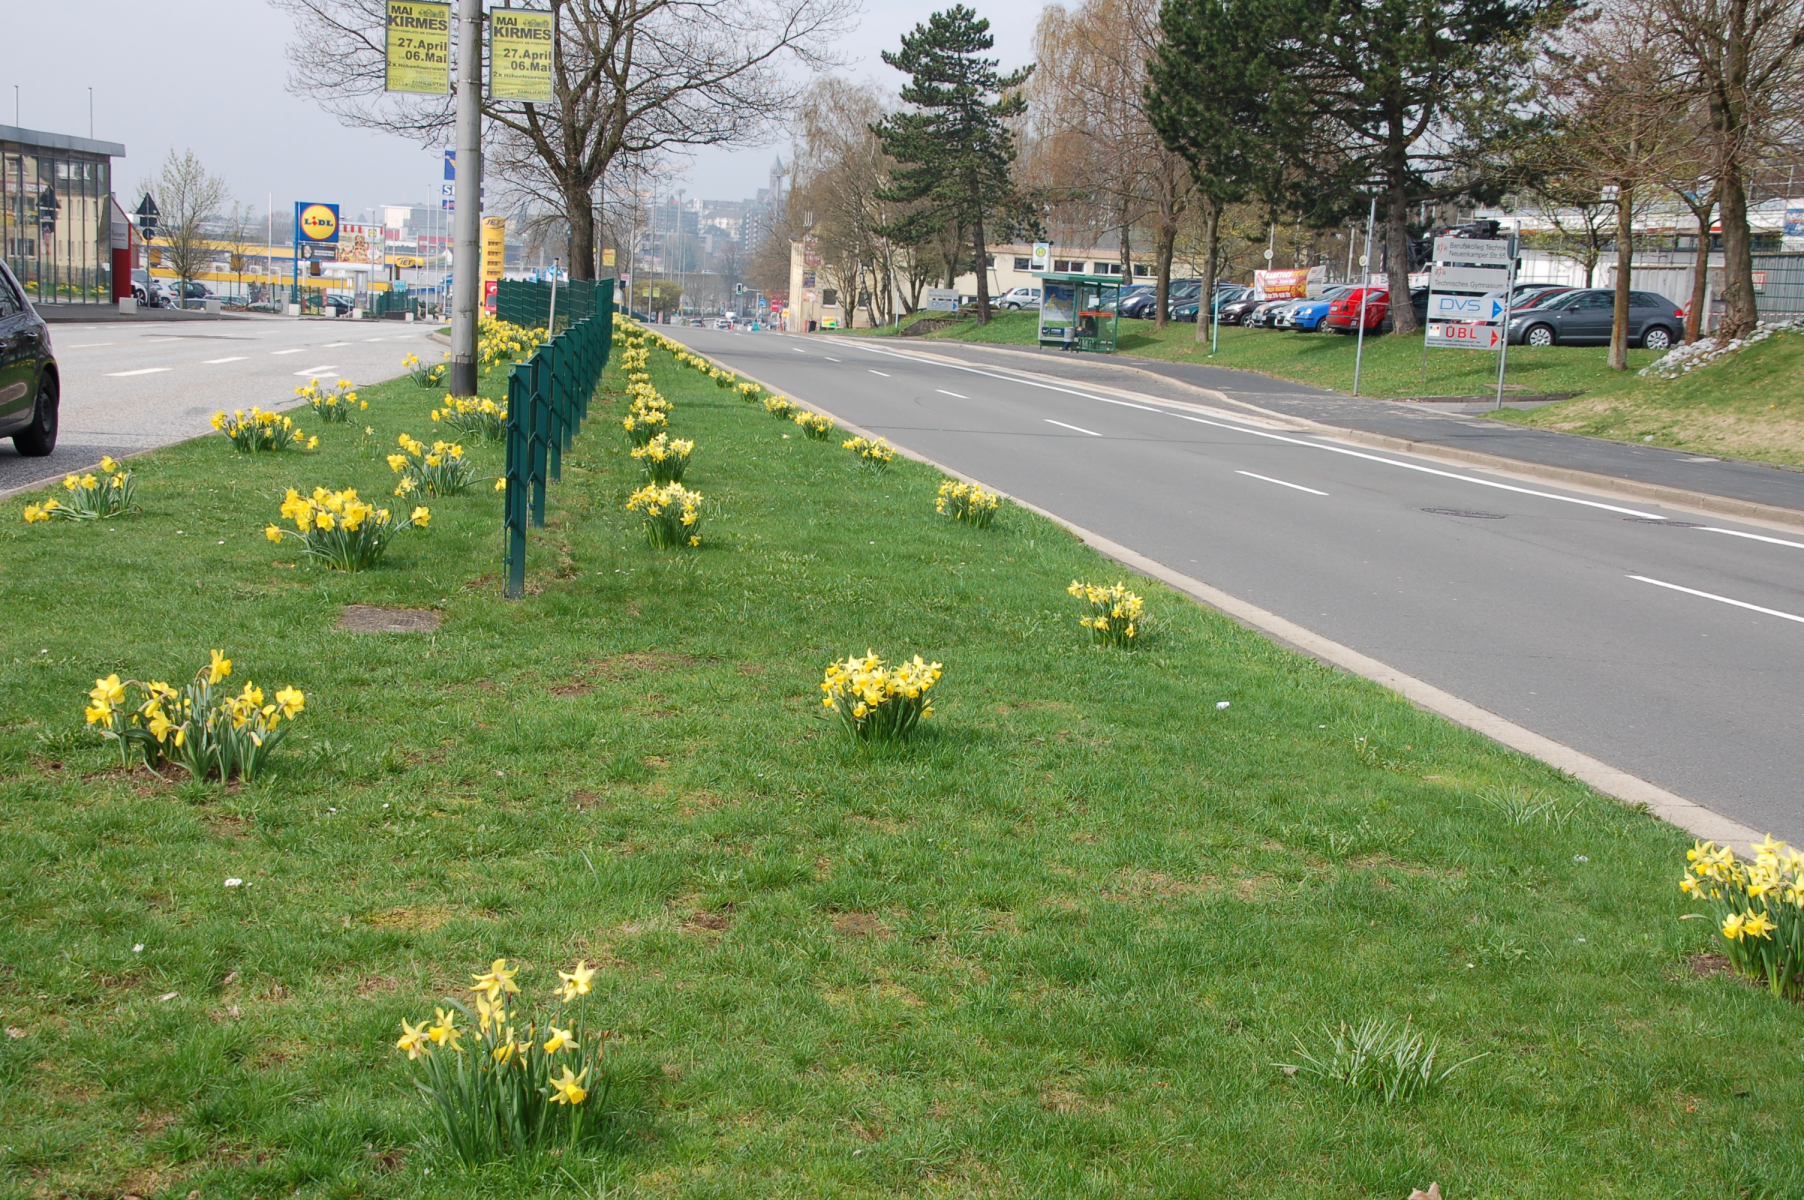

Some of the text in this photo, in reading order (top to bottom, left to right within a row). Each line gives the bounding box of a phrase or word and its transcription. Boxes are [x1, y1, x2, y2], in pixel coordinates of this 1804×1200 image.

[391, 5, 412, 16] MAI
[388, 15, 448, 31] KIRMES
[496, 16, 517, 26] MAI
[494, 26, 551, 40] KIRMES
[398, 37, 447, 51] 27.April
[405, 50, 447, 63] 06.Mai
[511, 60, 551, 72] 06.Mai
[485, 218, 502, 226] JET
[1449, 241, 1484, 251] Berufskolleg
[1448, 250, 1488, 259] Neuenkamper
[1434, 279, 1503, 289] Technisches Gymnasium
[1439, 297, 1481, 312] DVS
[1445, 325, 1477, 340] ÜBL
